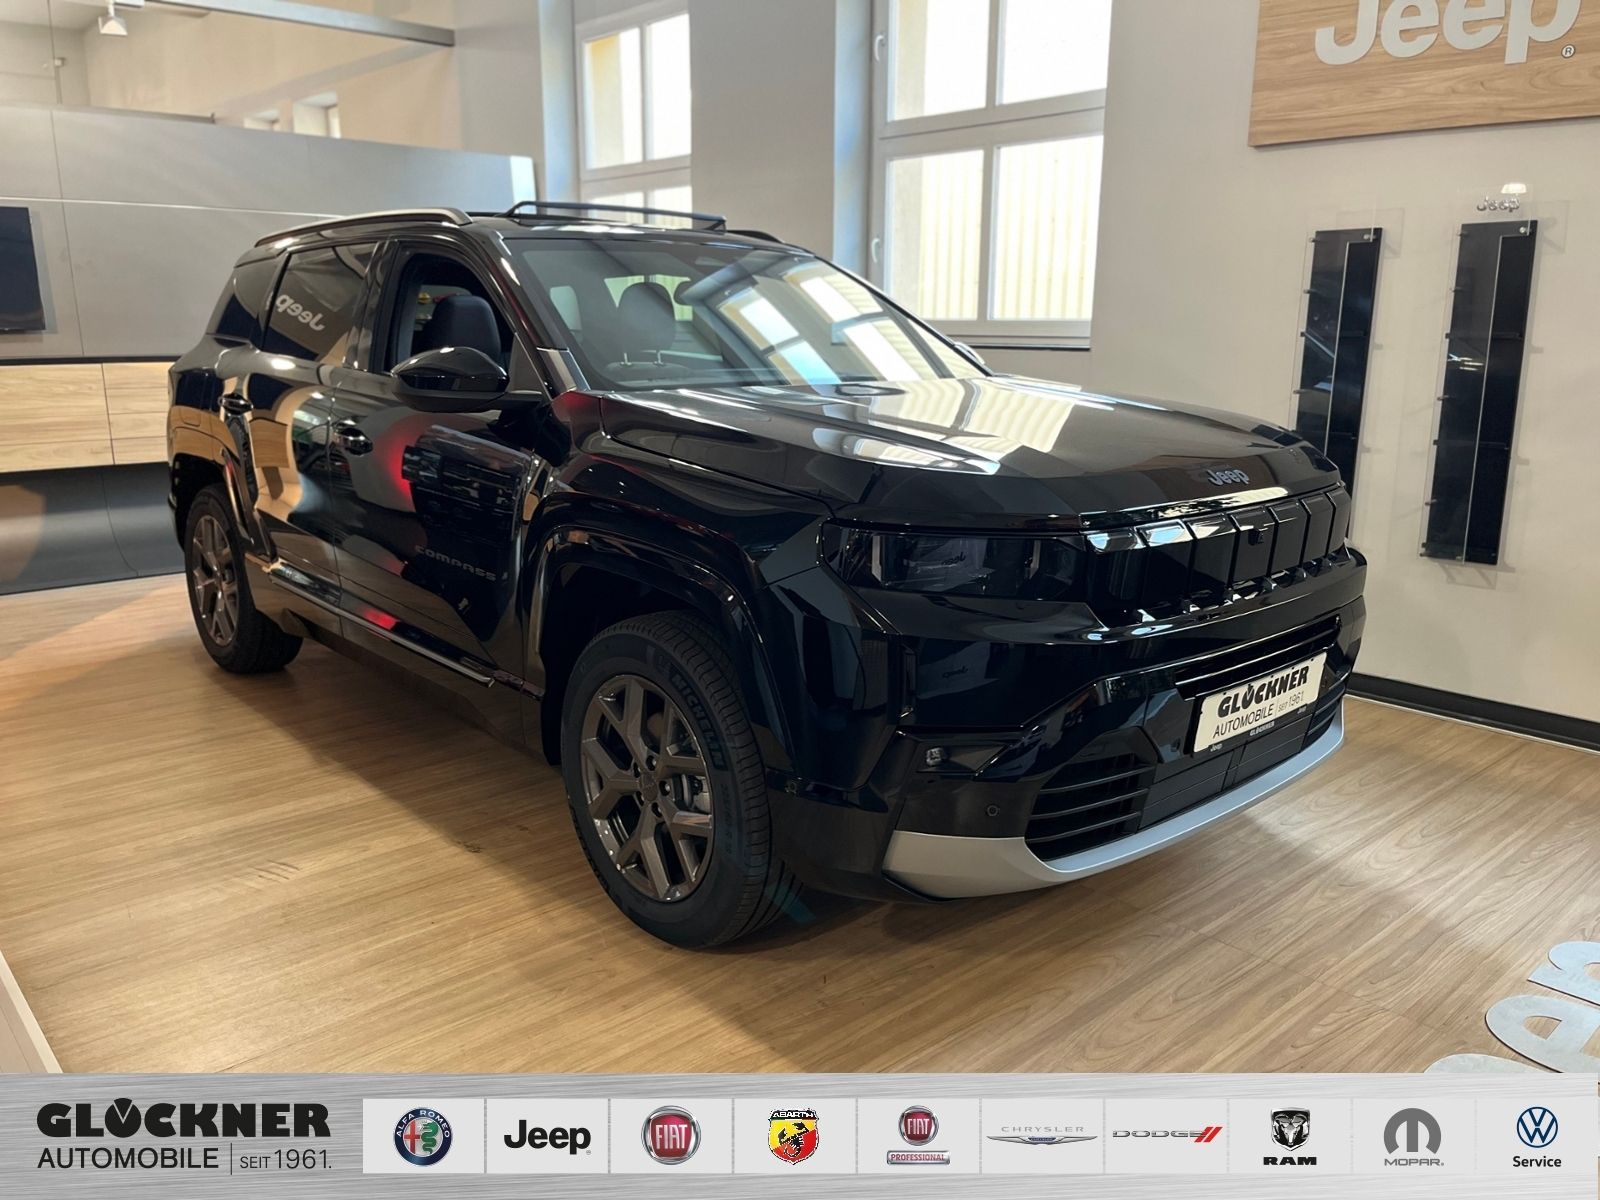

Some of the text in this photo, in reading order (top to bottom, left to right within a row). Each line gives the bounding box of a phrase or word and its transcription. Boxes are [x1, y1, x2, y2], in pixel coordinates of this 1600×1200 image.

[1315, 0, 1581, 65] Jeep
[1476, 195, 1520, 213] Jeep
[1206, 469, 1250, 486] Jeep
[415, 544, 497, 582] COMPASS
[1212, 703, 1275, 739] AUTOMOBILE
